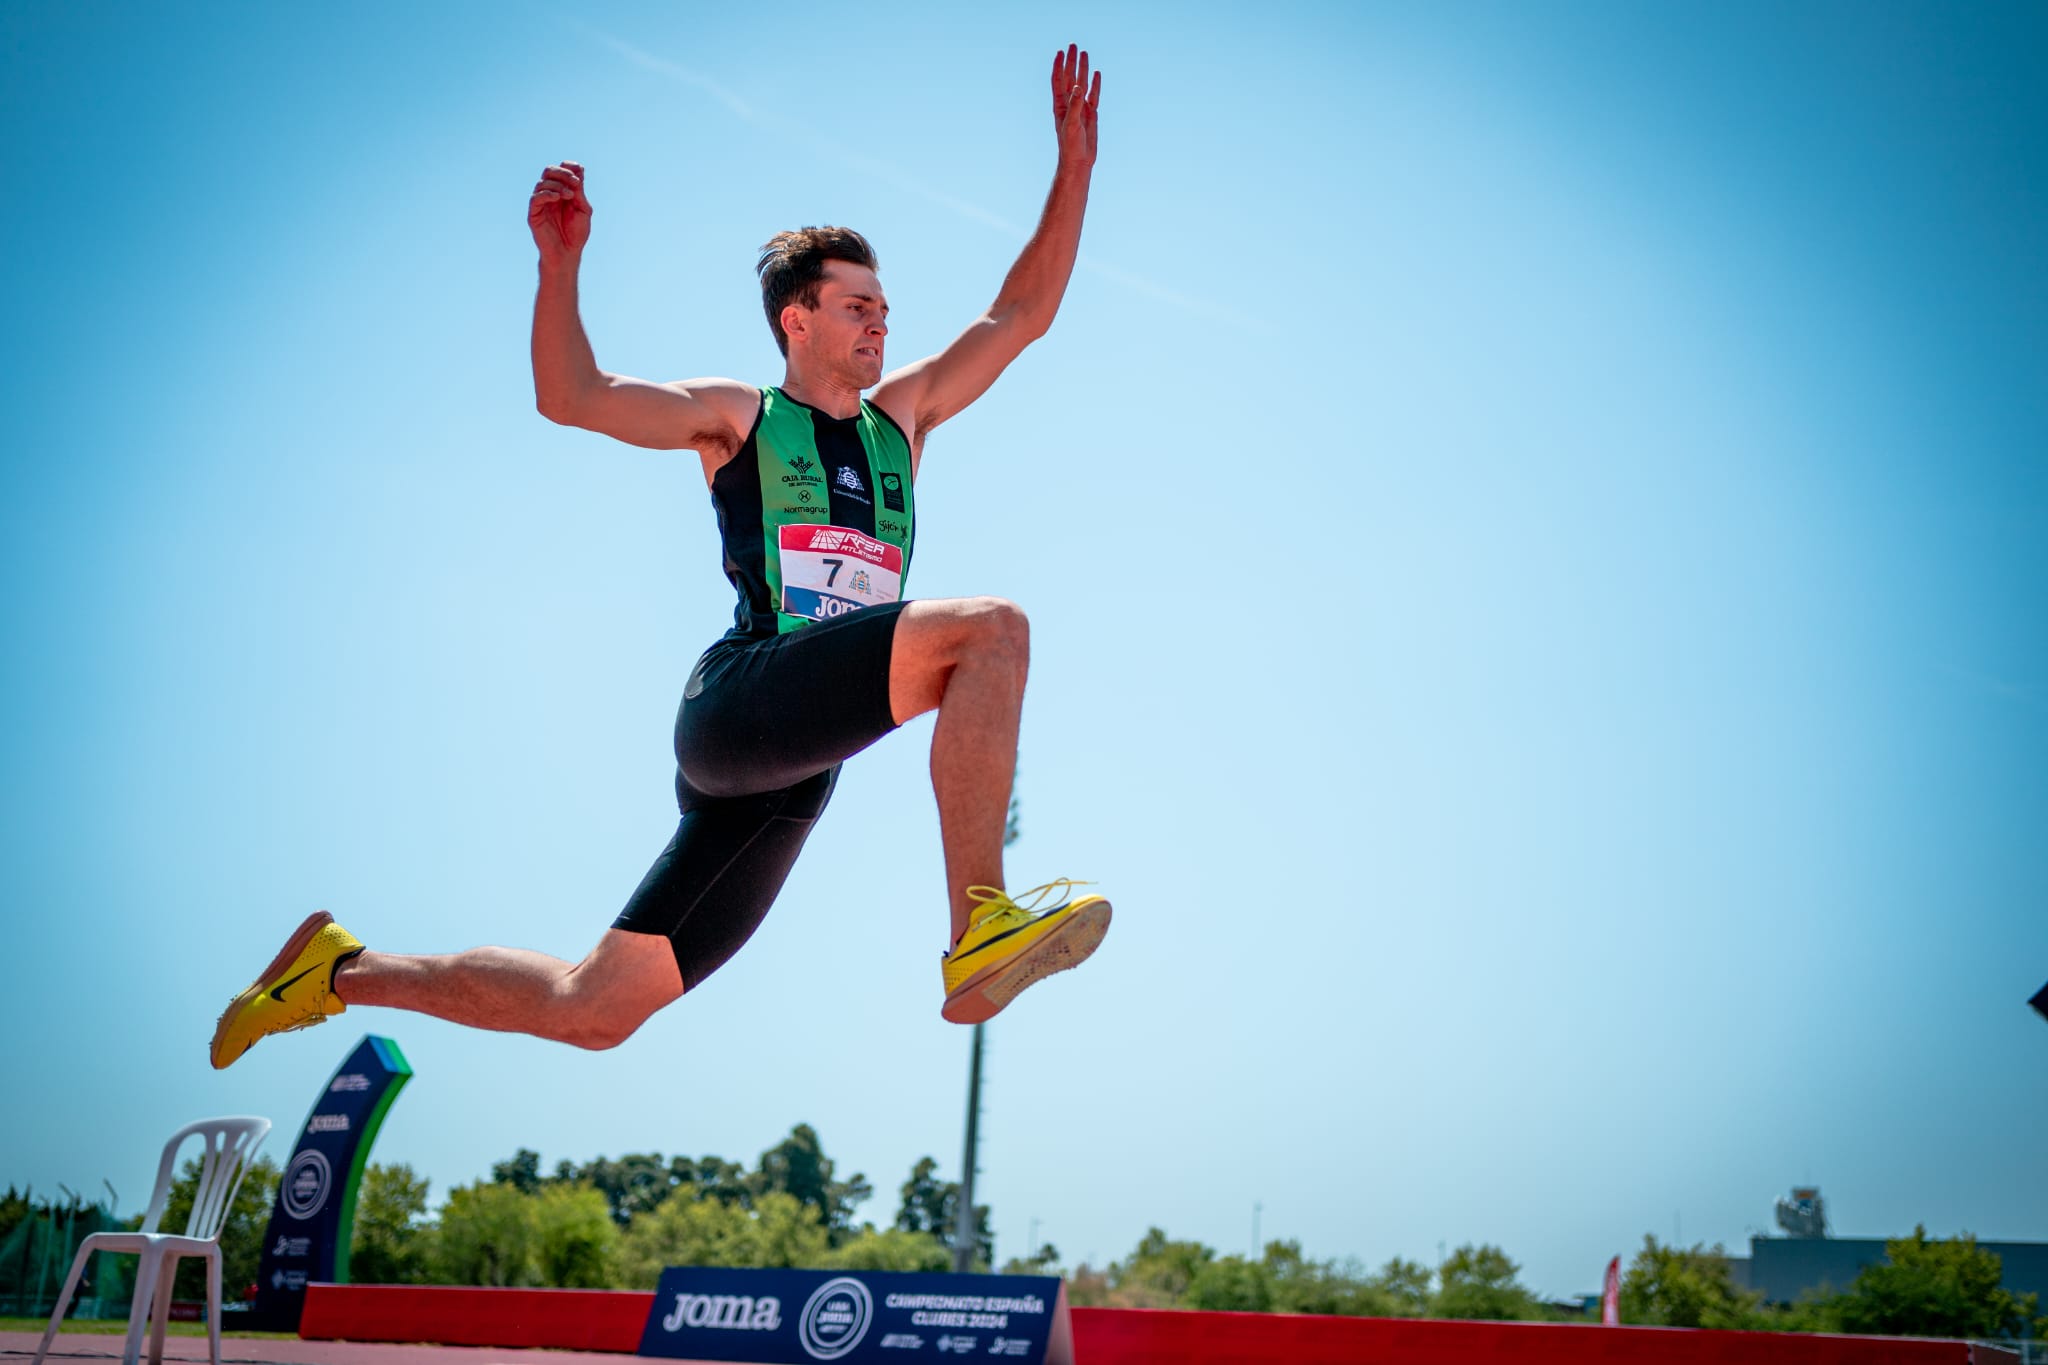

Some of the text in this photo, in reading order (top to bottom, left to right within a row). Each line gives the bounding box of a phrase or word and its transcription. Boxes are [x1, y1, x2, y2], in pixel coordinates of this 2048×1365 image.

[783, 506, 828, 515] Normagrup
[844, 533, 885, 555] RFEA
[822, 558, 843, 588] 7
[885, 1293, 1045, 1313] CAMPEONATO ESPAÑA
[911, 1310, 966, 1327] CLUBES
